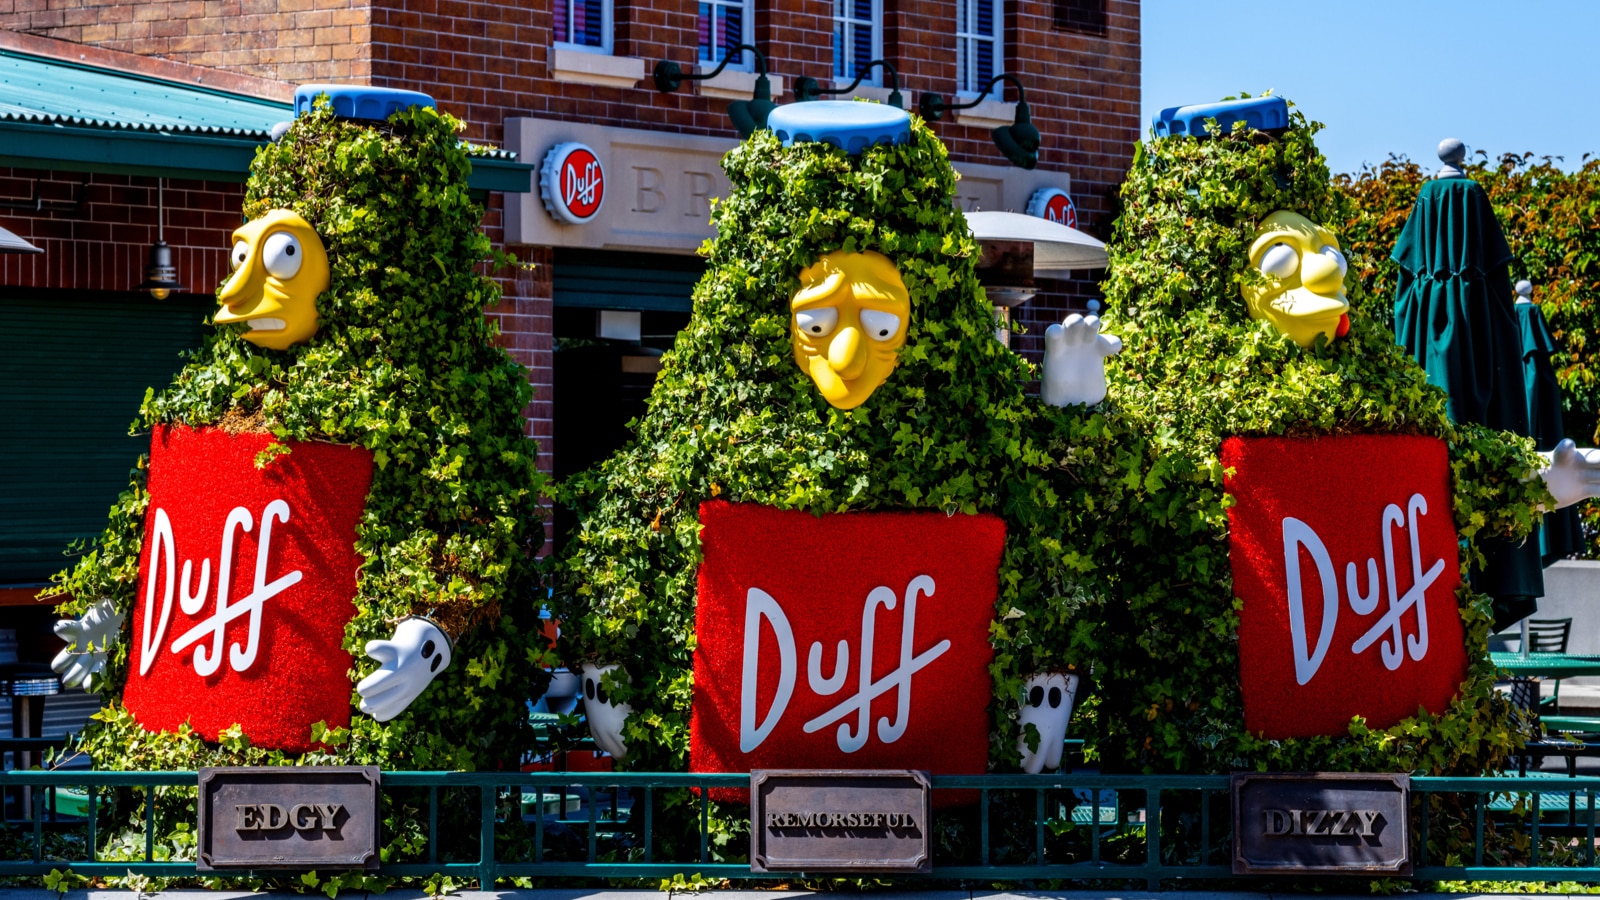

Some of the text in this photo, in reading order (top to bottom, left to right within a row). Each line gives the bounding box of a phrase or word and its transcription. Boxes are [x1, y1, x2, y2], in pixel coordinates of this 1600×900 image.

[566, 160, 601, 206] Duff
[139, 498, 303, 677] Duff
[1282, 493, 1446, 686] Duff
[739, 574, 951, 753] Duff
[234, 803, 343, 831] EDGY
[767, 811, 915, 828] REMORSEFUL
[1263, 808, 1381, 837] DIZZY
